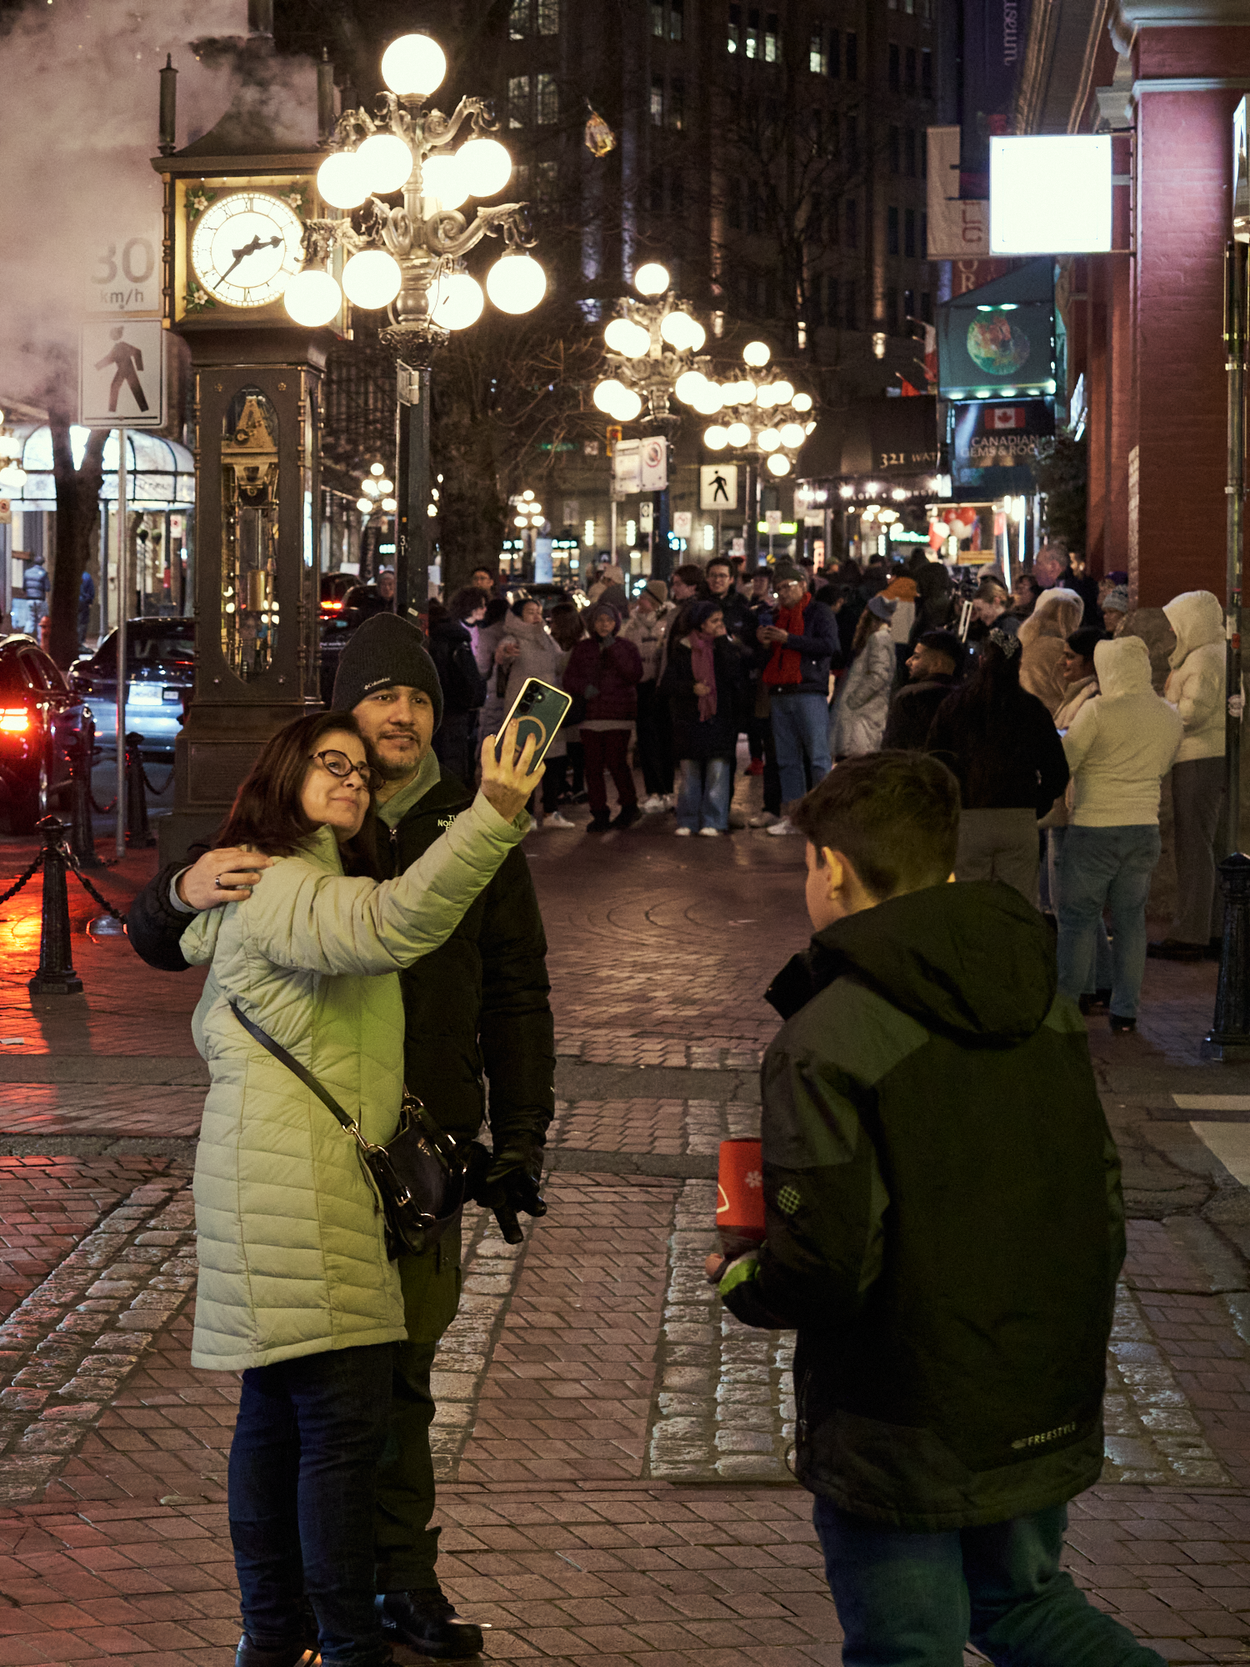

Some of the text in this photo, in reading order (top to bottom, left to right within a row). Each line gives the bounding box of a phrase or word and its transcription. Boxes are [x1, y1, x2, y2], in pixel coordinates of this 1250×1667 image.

[90, 237, 155, 285] 30
[100, 288, 144, 306] km/h
[971, 434, 1039, 447] CANADIAN
[960, 443, 1035, 457] GEMS & ROC
[879, 452, 905, 469] 321
